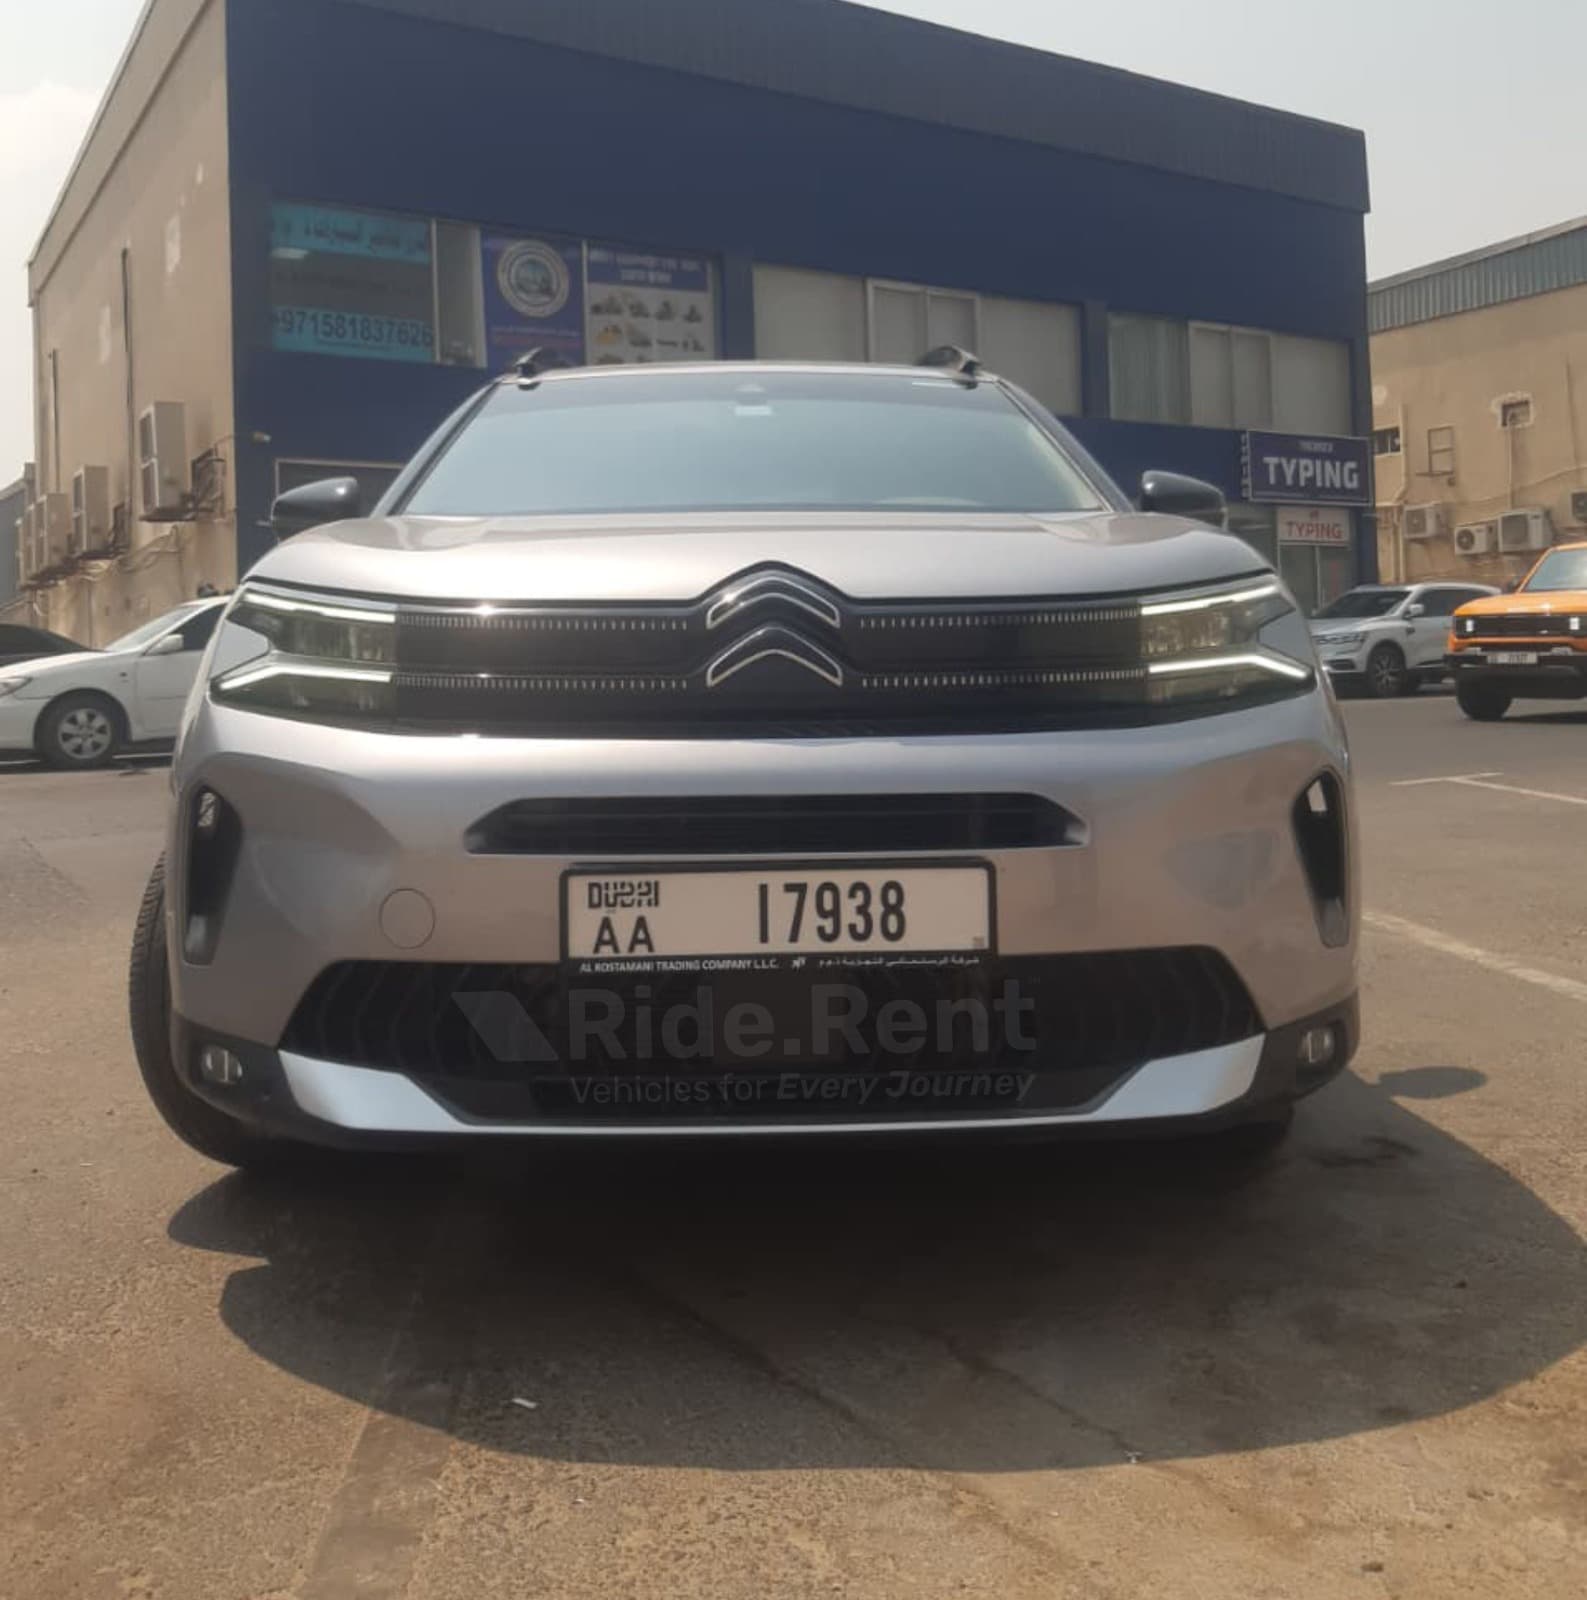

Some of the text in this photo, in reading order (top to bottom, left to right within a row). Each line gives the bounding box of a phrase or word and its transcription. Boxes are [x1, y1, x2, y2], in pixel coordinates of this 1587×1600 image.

[1262, 456, 1360, 490] TYPING
[1286, 519, 1343, 539] TYPING
[588, 880, 660, 909] DUBAI
[757, 880, 907, 945] 17938
[593, 915, 655, 955] AA
[656, 959, 700, 972] TRADING
[701, 958, 752, 970] COMPANY
